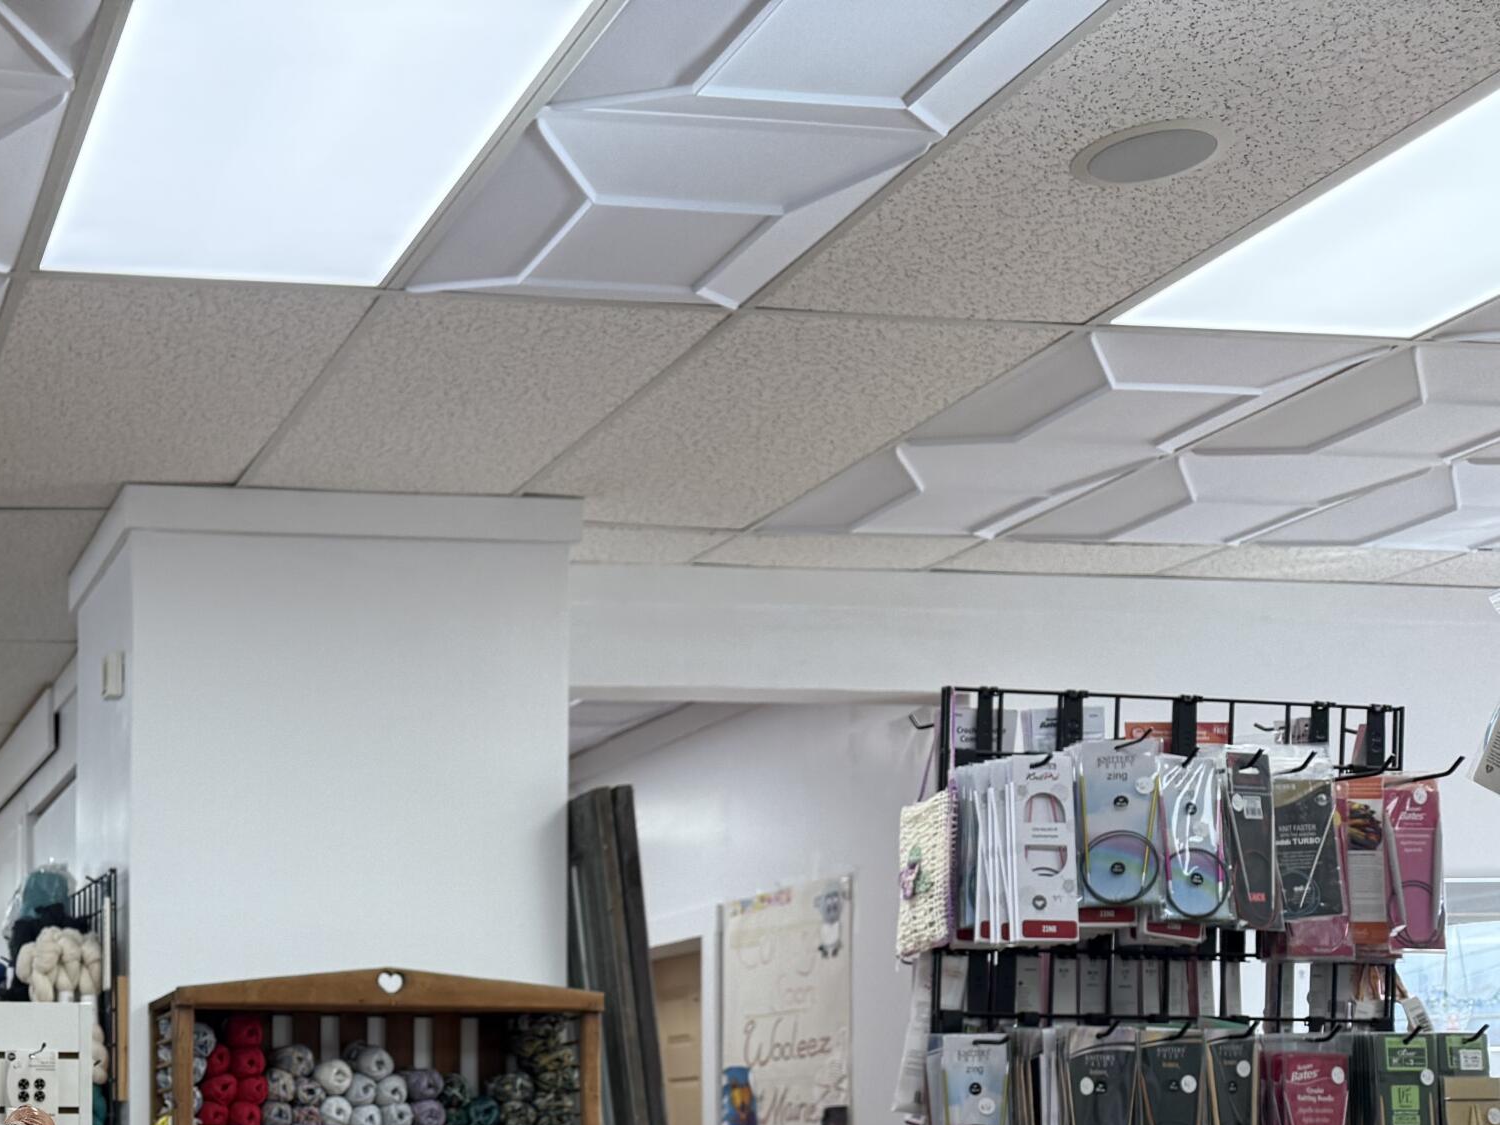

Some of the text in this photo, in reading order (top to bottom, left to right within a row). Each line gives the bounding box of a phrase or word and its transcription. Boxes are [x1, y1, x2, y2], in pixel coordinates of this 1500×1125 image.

[1106, 770, 1129, 782] zing
[1293, 837, 1321, 846] TURBO
[1291, 1070, 1319, 1082] Bates
